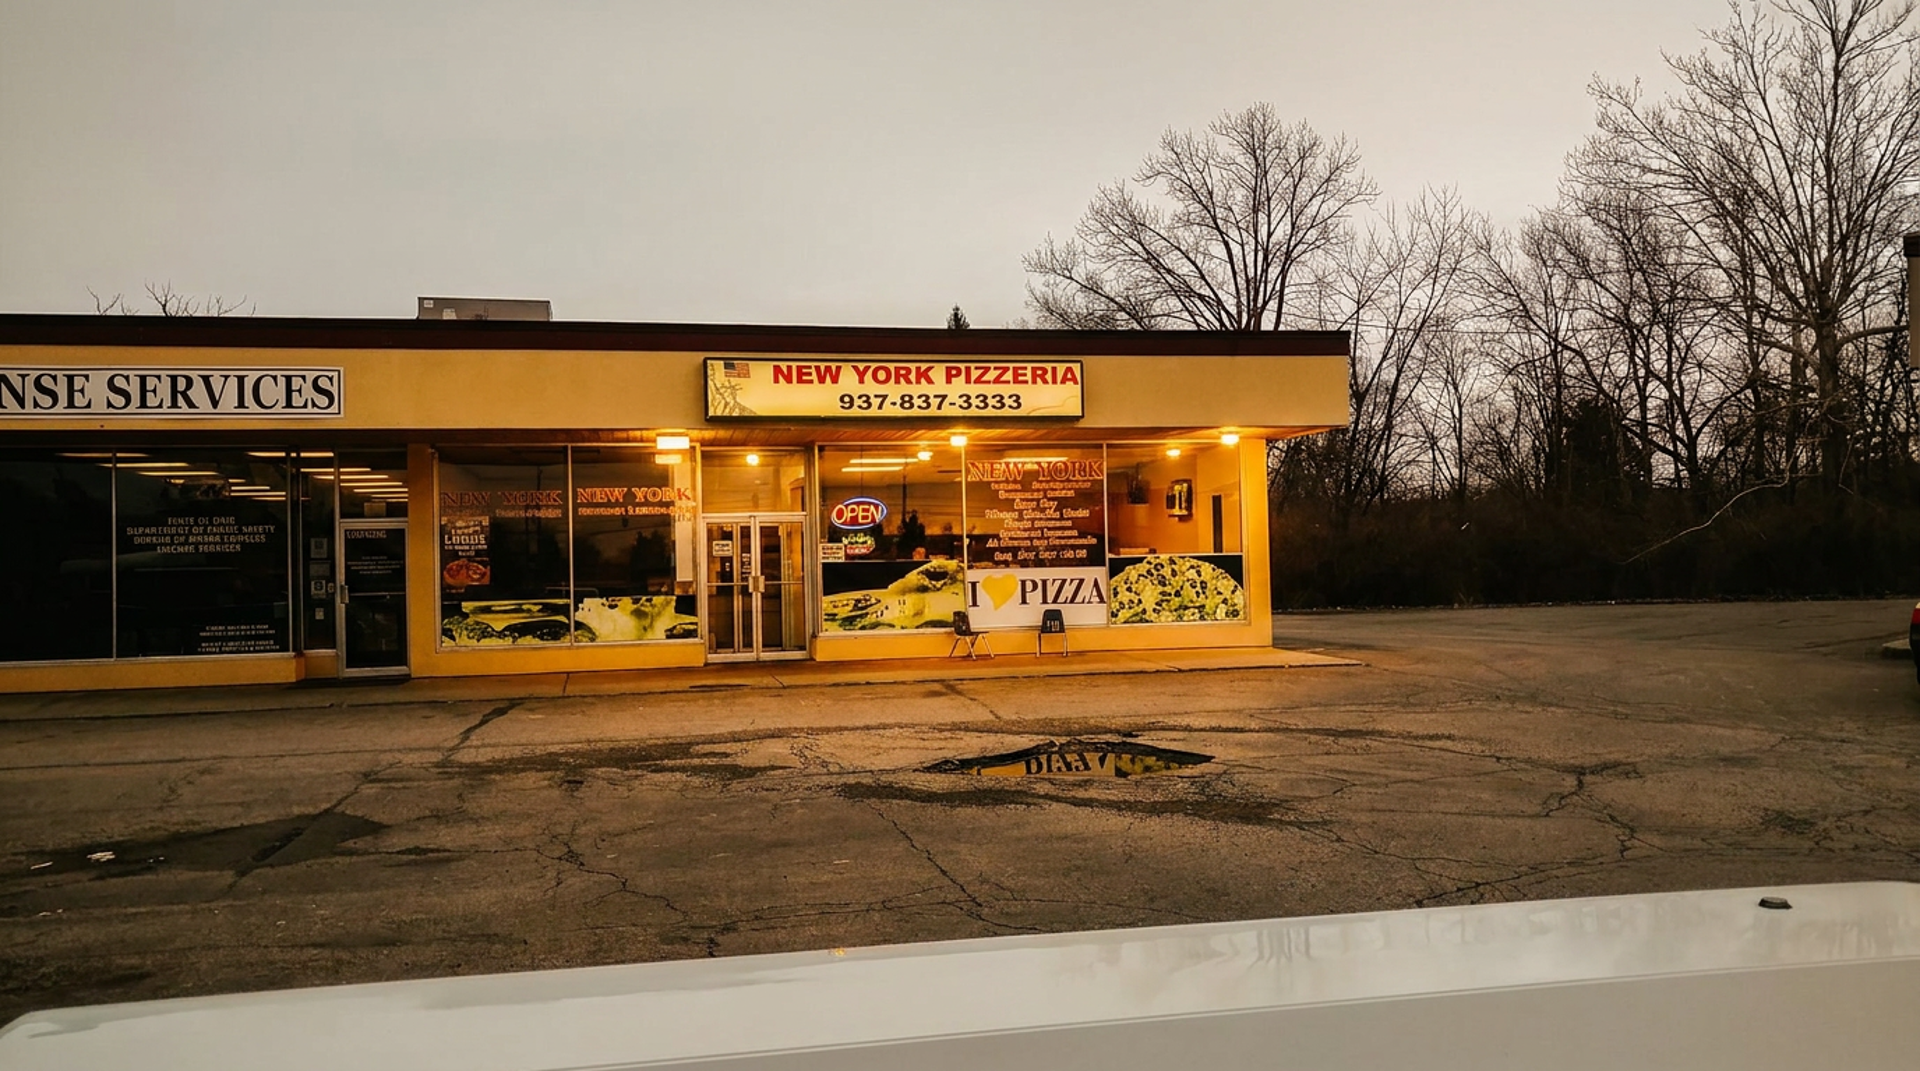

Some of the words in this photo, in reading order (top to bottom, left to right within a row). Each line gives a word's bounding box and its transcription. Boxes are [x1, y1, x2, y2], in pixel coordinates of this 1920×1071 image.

[772, 365, 842, 385] NEW
[851, 365, 935, 385] YORK
[945, 365, 1079, 386] PIZZERIA
[0, 373, 92, 410] NSE
[106, 373, 336, 410] SERVICES
[839, 393, 1022, 411] 937-837-3333
[967, 459, 1025, 482] NEW
[1037, 459, 1104, 480] YORK
[577, 487, 628, 503] NEW
[631, 487, 692, 503] YORK
[833, 504, 882, 524] OPEN
[968, 581, 980, 608] I
[1019, 577, 1107, 605] PIZZA
